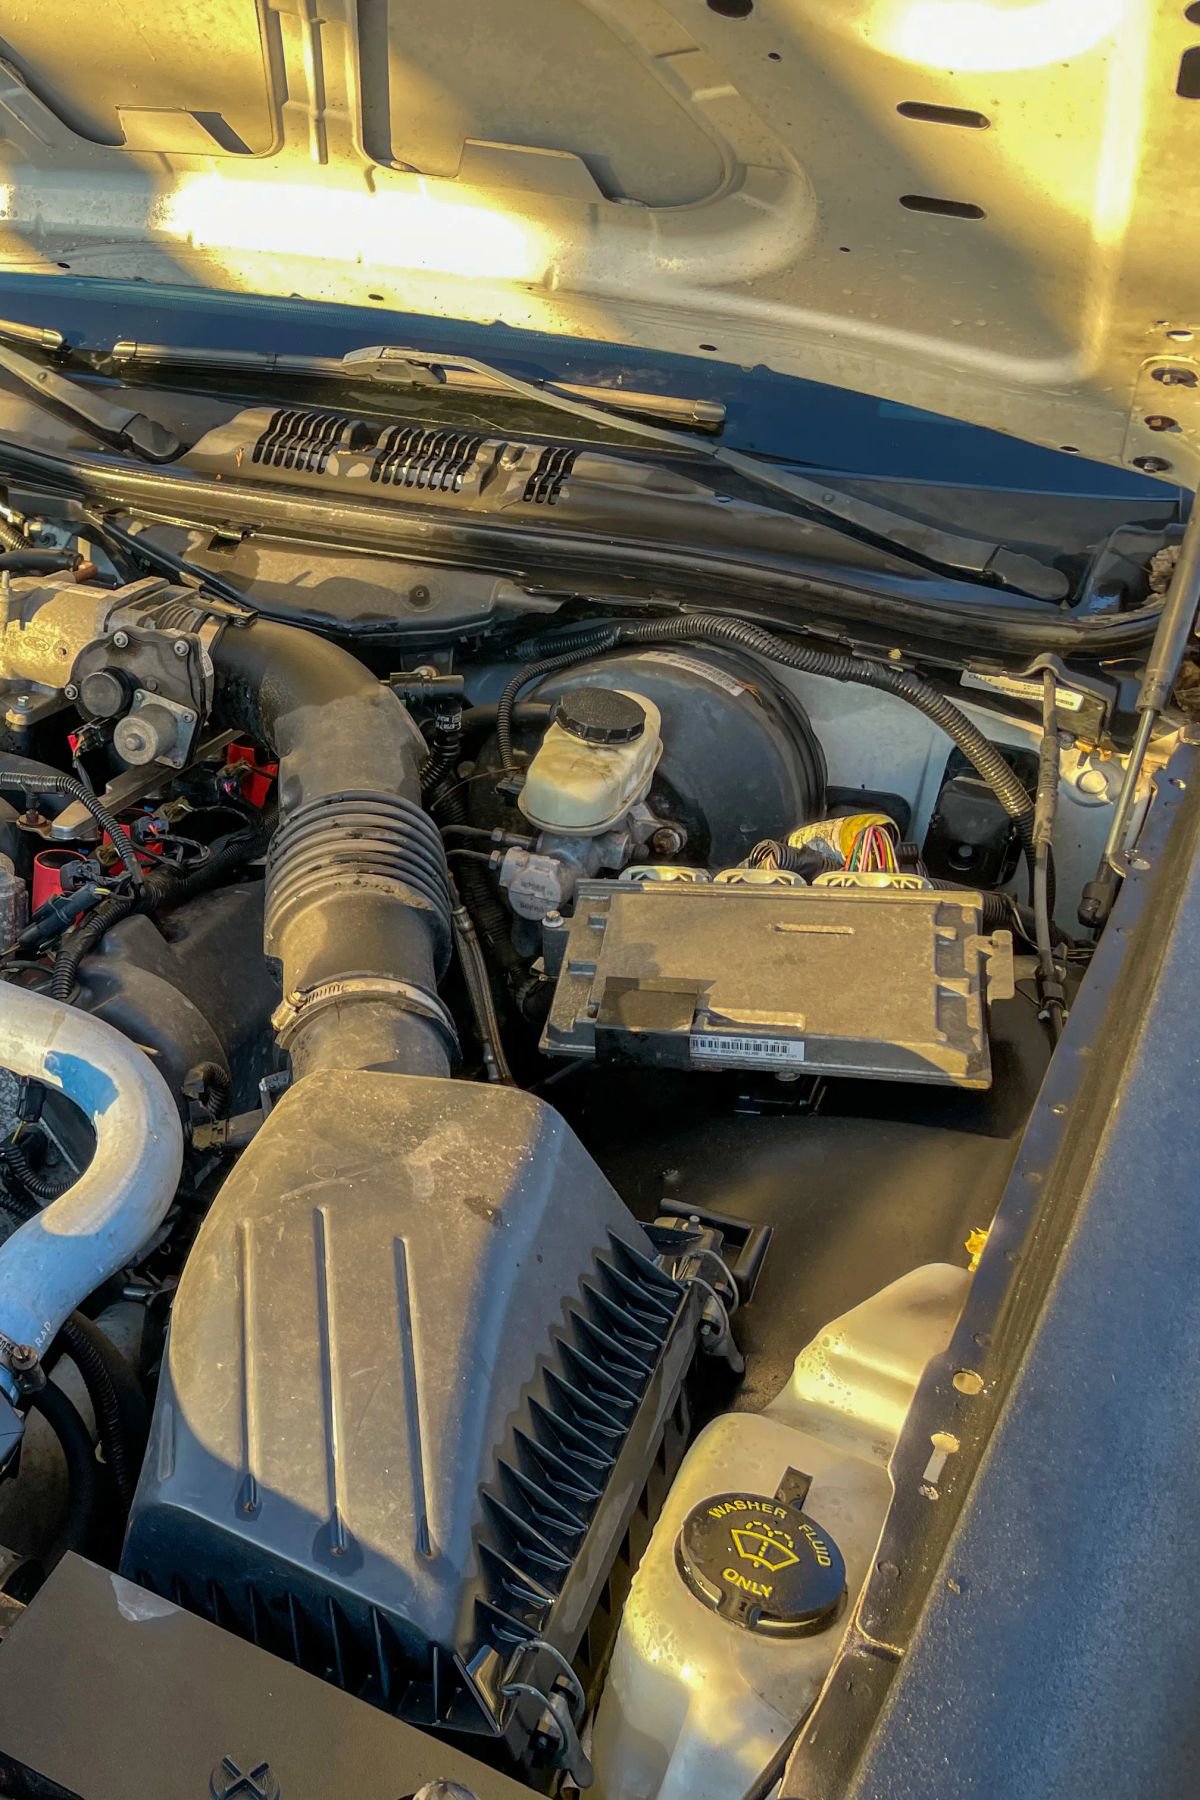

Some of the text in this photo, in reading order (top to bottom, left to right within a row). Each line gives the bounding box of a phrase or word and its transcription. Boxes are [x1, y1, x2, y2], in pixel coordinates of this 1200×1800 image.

[34, 1321, 52, 1346] RAD
[708, 1500, 832, 1567] WASHER FLUID
[722, 1567, 773, 1598] ONLY
